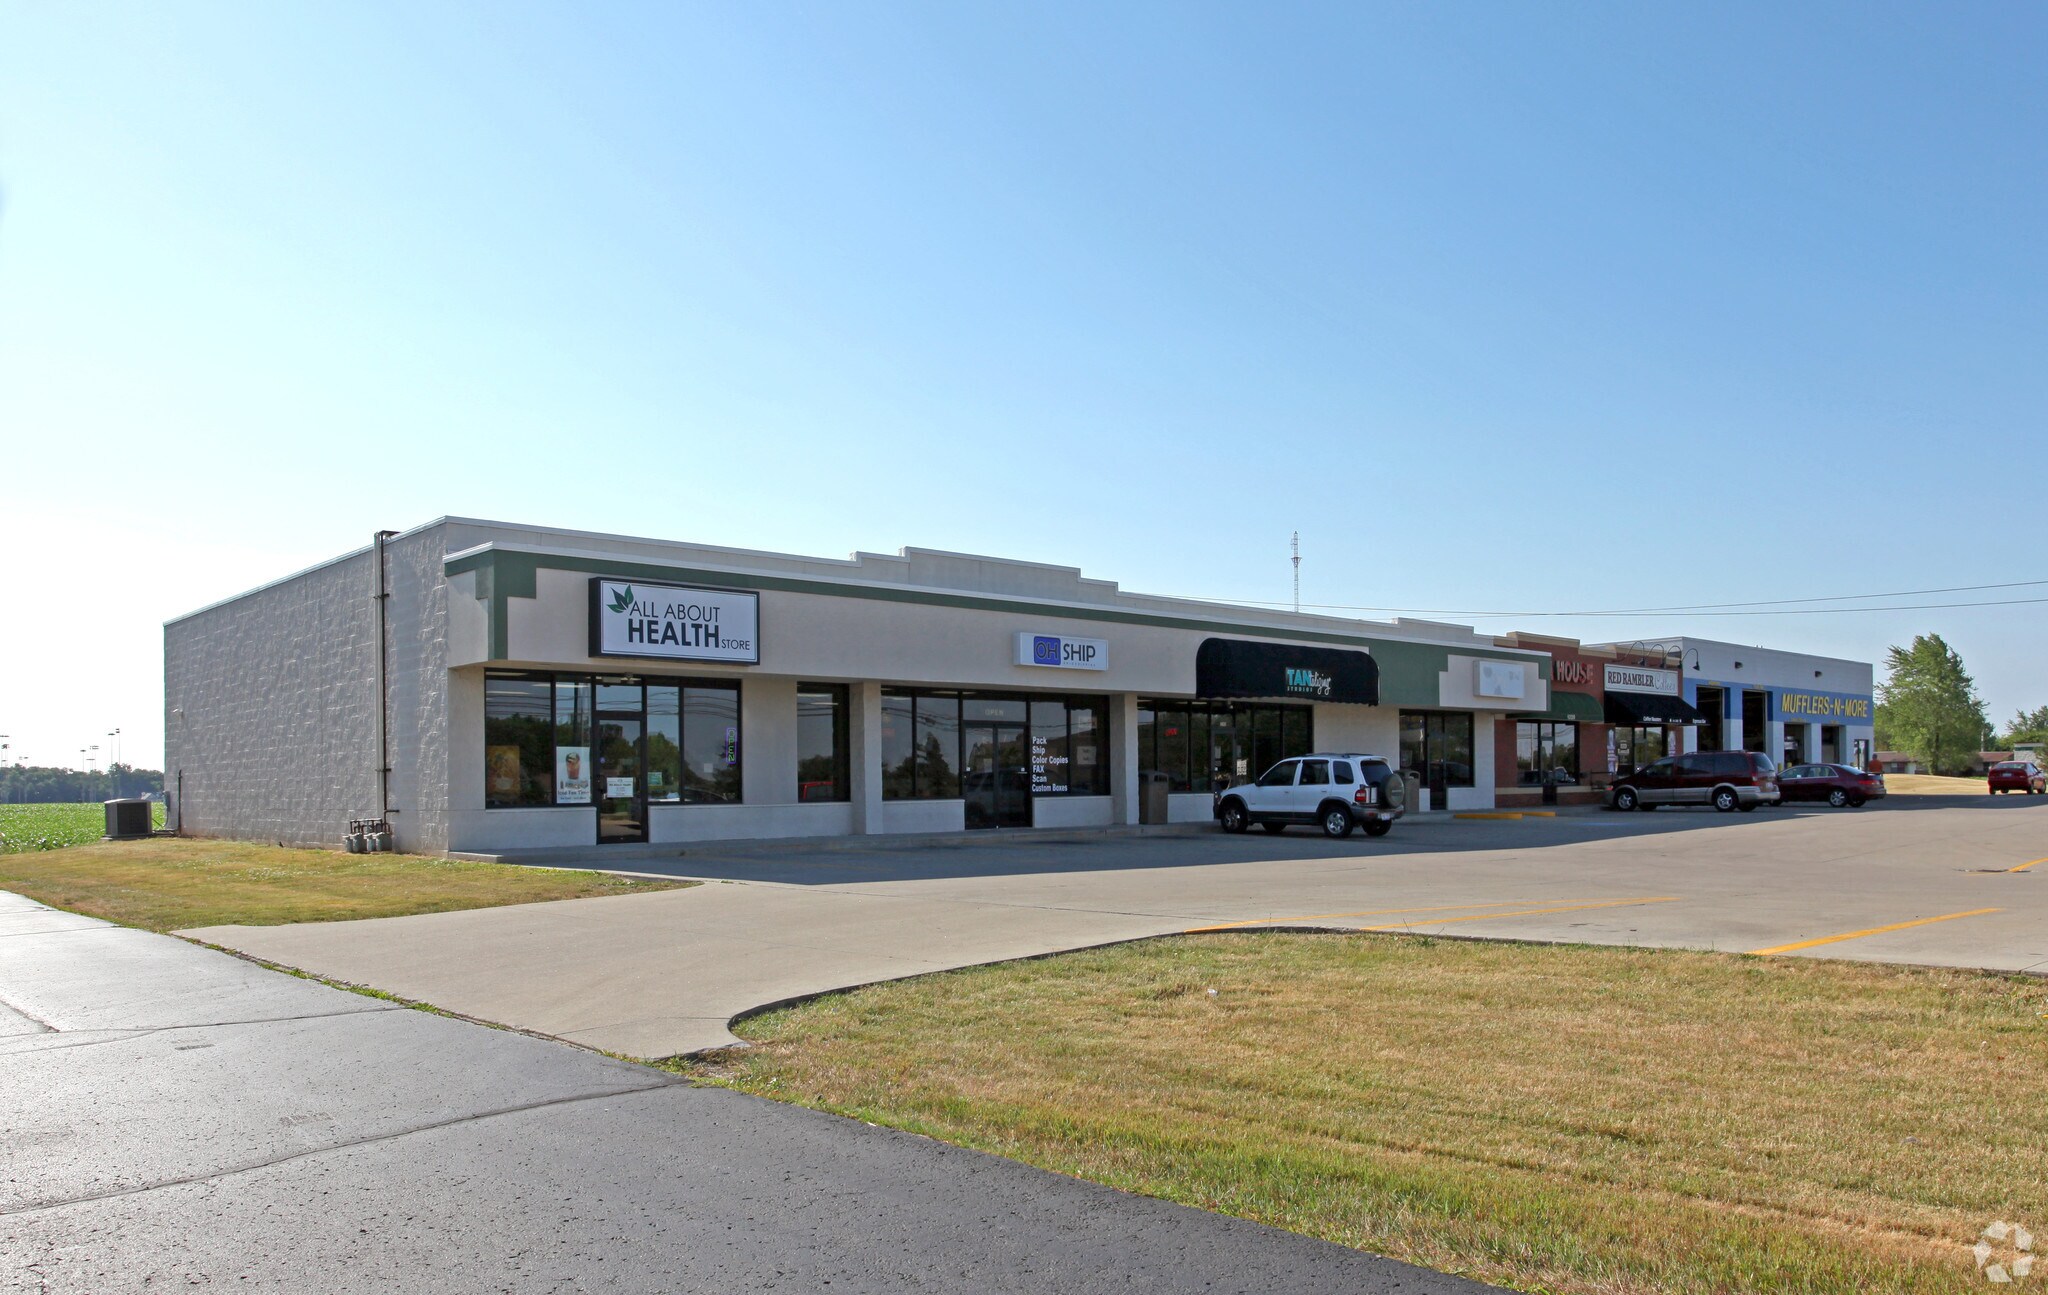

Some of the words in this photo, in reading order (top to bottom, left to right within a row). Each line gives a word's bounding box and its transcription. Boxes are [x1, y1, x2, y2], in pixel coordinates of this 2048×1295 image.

[629, 601, 659, 618] ALL
[664, 604, 720, 622] ABOUT
[628, 618, 719, 648] HEALTH
[721, 638, 750, 650] STORE
[1035, 642, 1058, 660] OH
[1063, 643, 1096, 662] SHIP
[1556, 660, 1594, 684] HOUSE
[1607, 671, 1621, 684] RED
[1622, 672, 1655, 688] RAMBLER
[1782, 693, 1868, 717] MUFFLERS-N-MORE
[1032, 736, 1047, 745] Pack
[1032, 746, 1045, 755] Ship
[1032, 755, 1048, 764] Color
[1049, 756, 1069, 766] Copies
[1032, 765, 1045, 773] FAX
[1032, 774, 1047, 783] Scan
[1031, 783, 1051, 792] Custom
[1052, 783, 1068, 792] Boxes
